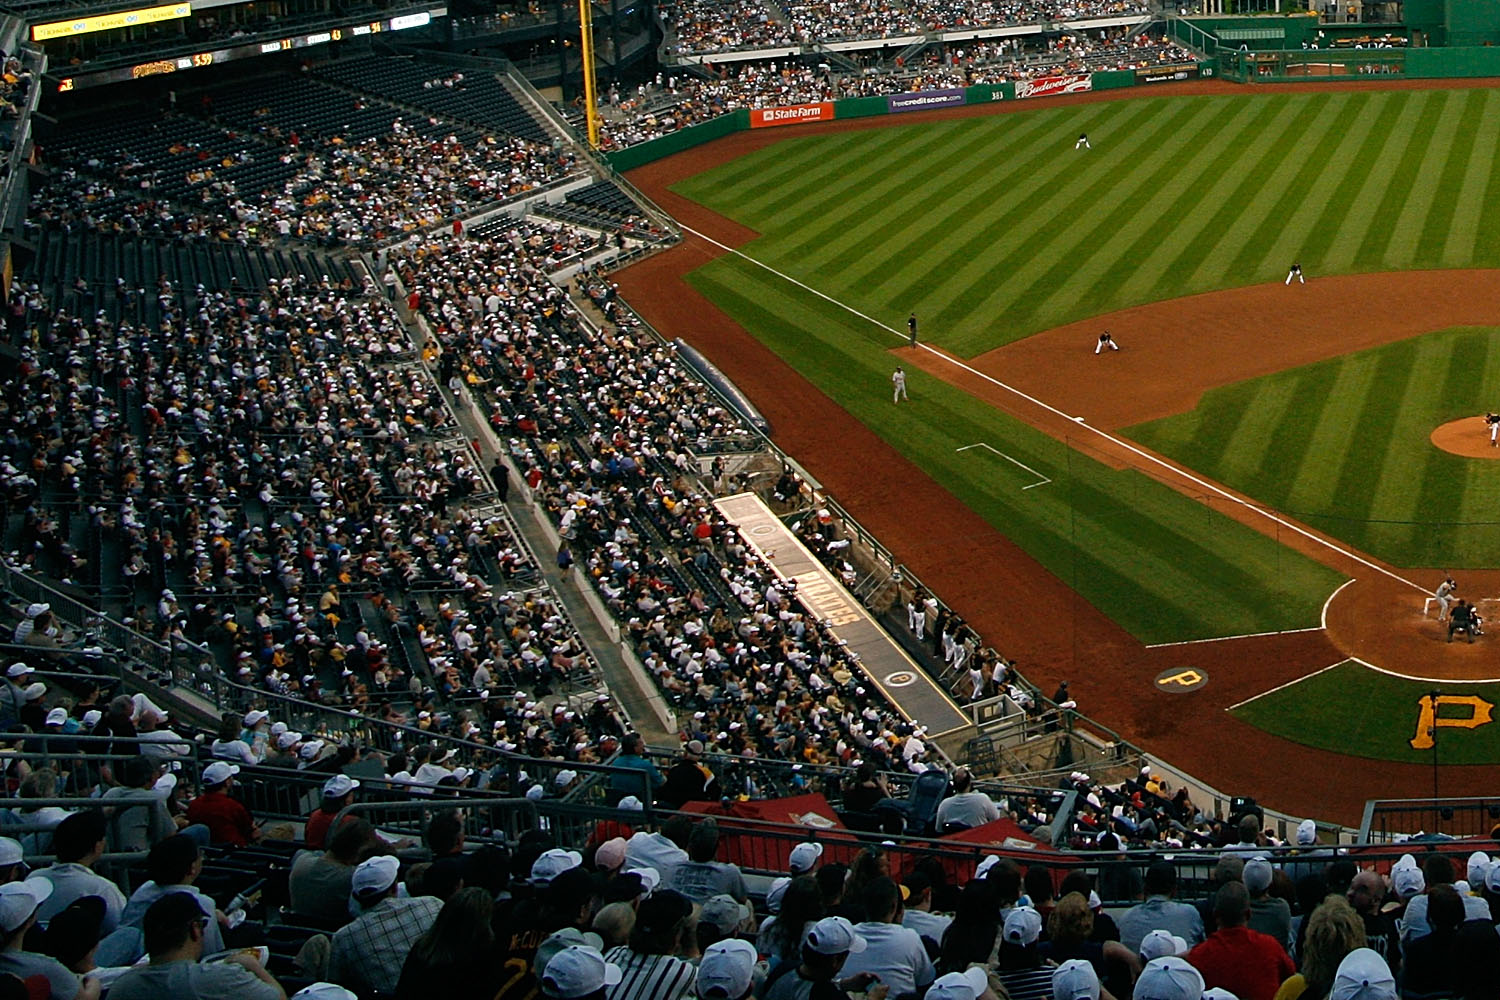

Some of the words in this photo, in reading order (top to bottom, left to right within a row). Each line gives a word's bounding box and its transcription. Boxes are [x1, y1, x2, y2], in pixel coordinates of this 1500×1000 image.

[1024, 75, 1080, 97] Budweiser
[892, 93, 962, 108] freecreditscore.com
[774, 109, 797, 120] State
[797, 106, 821, 117] Farm
[791, 570, 862, 627] PIRATES
[1157, 670, 1202, 686] P
[1408, 693, 1495, 750] P
